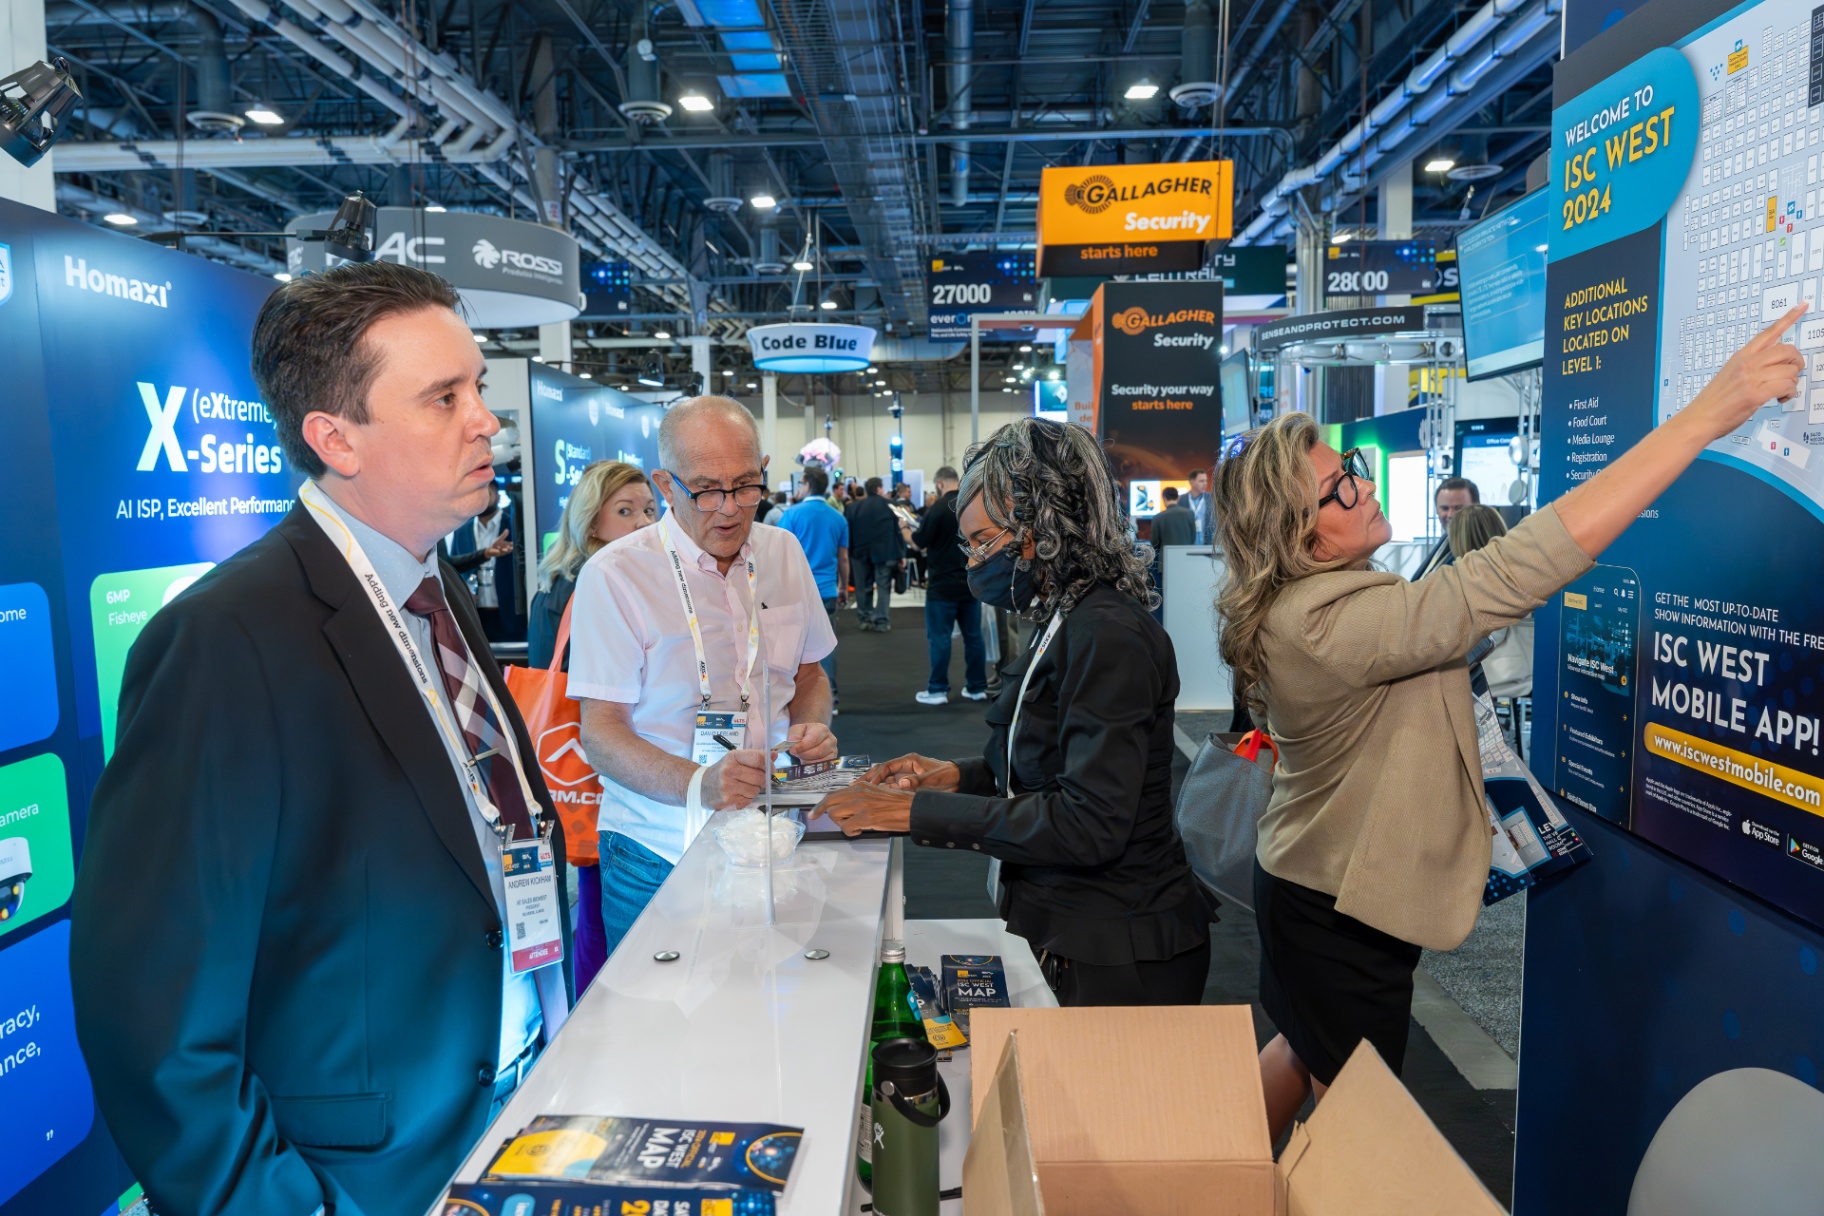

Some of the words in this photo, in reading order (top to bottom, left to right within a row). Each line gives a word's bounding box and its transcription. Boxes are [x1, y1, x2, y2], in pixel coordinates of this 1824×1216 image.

[1565, 97, 1630, 148] WELCOME
[1634, 84, 1653, 111] TO
[1565, 147, 1597, 192] ISC
[1605, 106, 1675, 172] WEST
[1086, 177, 1212, 204] GALLAGHER
[1563, 182, 1611, 230] 2024
[1124, 210, 1211, 234] Security
[1080, 246, 1121, 260] starts
[1124, 245, 1158, 258] here
[932, 283, 991, 305] 27000
[1564, 277, 1628, 310] ADDITIONAL
[1126, 309, 1216, 329] GALLAGHER
[1563, 312, 1583, 332] KEY
[1585, 295, 1648, 326] LOCATIONS
[1261, 315, 1405, 341] SENSEANDPROTECT.COM
[1563, 329, 1608, 354] LOCATED
[1611, 324, 1629, 343] ON
[761, 335, 807, 351] Code
[814, 334, 858, 351] Blue
[1153, 333, 1214, 350] Security
[1562, 355, 1593, 376] LEVEL
[1111, 384, 1160, 397] Security
[1160, 386, 1188, 397] your
[1190, 386, 1214, 397] way
[1132, 400, 1165, 410] starts
[1166, 399, 1193, 410] here
[1573, 399, 1587, 410] First
[1588, 397, 1599, 408] Aid
[136, 381, 188, 472] X
[193, 388, 277, 430] (eXtreme
[1572, 416, 1588, 428] Food
[1589, 415, 1607, 426] Court
[1572, 434, 1591, 446] Media
[1592, 433, 1615, 445] Lounge
[187, 433, 282, 474] -Series
[1571, 451, 1608, 464] Registration
[116, 499, 133, 519] AI
[137, 499, 165, 521] ISP,
[168, 497, 228, 518] Excellent
[230, 496, 295, 515] Performanc
[106, 589, 131, 604] 6MP
[1655, 592, 1672, 604] GET
[1673, 594, 1690, 608] THE
[1694, 598, 1720, 613] MOST
[1722, 602, 1779, 623] UP-TO-DATE
[108, 610, 148, 626] Fisheye
[365, 573, 389, 608] Adding
[386, 609, 401, 629] new
[398, 630, 429, 684] dimensions
[1654, 608, 1680, 622] SHOW
[1681, 613, 1747, 636] INFORMATION
[1749, 624, 1776, 641] WITH
[1779, 629, 1800, 646] THE
[1567, 653, 1590, 667] Navigate
[1590, 659, 1600, 670] ISC
[1600, 662, 1615, 674] West
[1654, 631, 1688, 667] ISC
[1697, 640, 1770, 686] WEST
[1652, 675, 1747, 733] MOBILE
[1754, 705, 1820, 756] APP!
[1654, 735, 1821, 807] www.iscwestmobile.com
[1752, 826, 1764, 840] App
[1764, 831, 1780, 846] Store
[1801, 849, 1824, 865] Google
[508, 878, 530, 889] ANDREW
[957, 988, 997, 997] MAP
[678, 1129, 697, 1143] ISC
[637, 1127, 681, 1169] MAP
[665, 1143, 690, 1168] WEST
